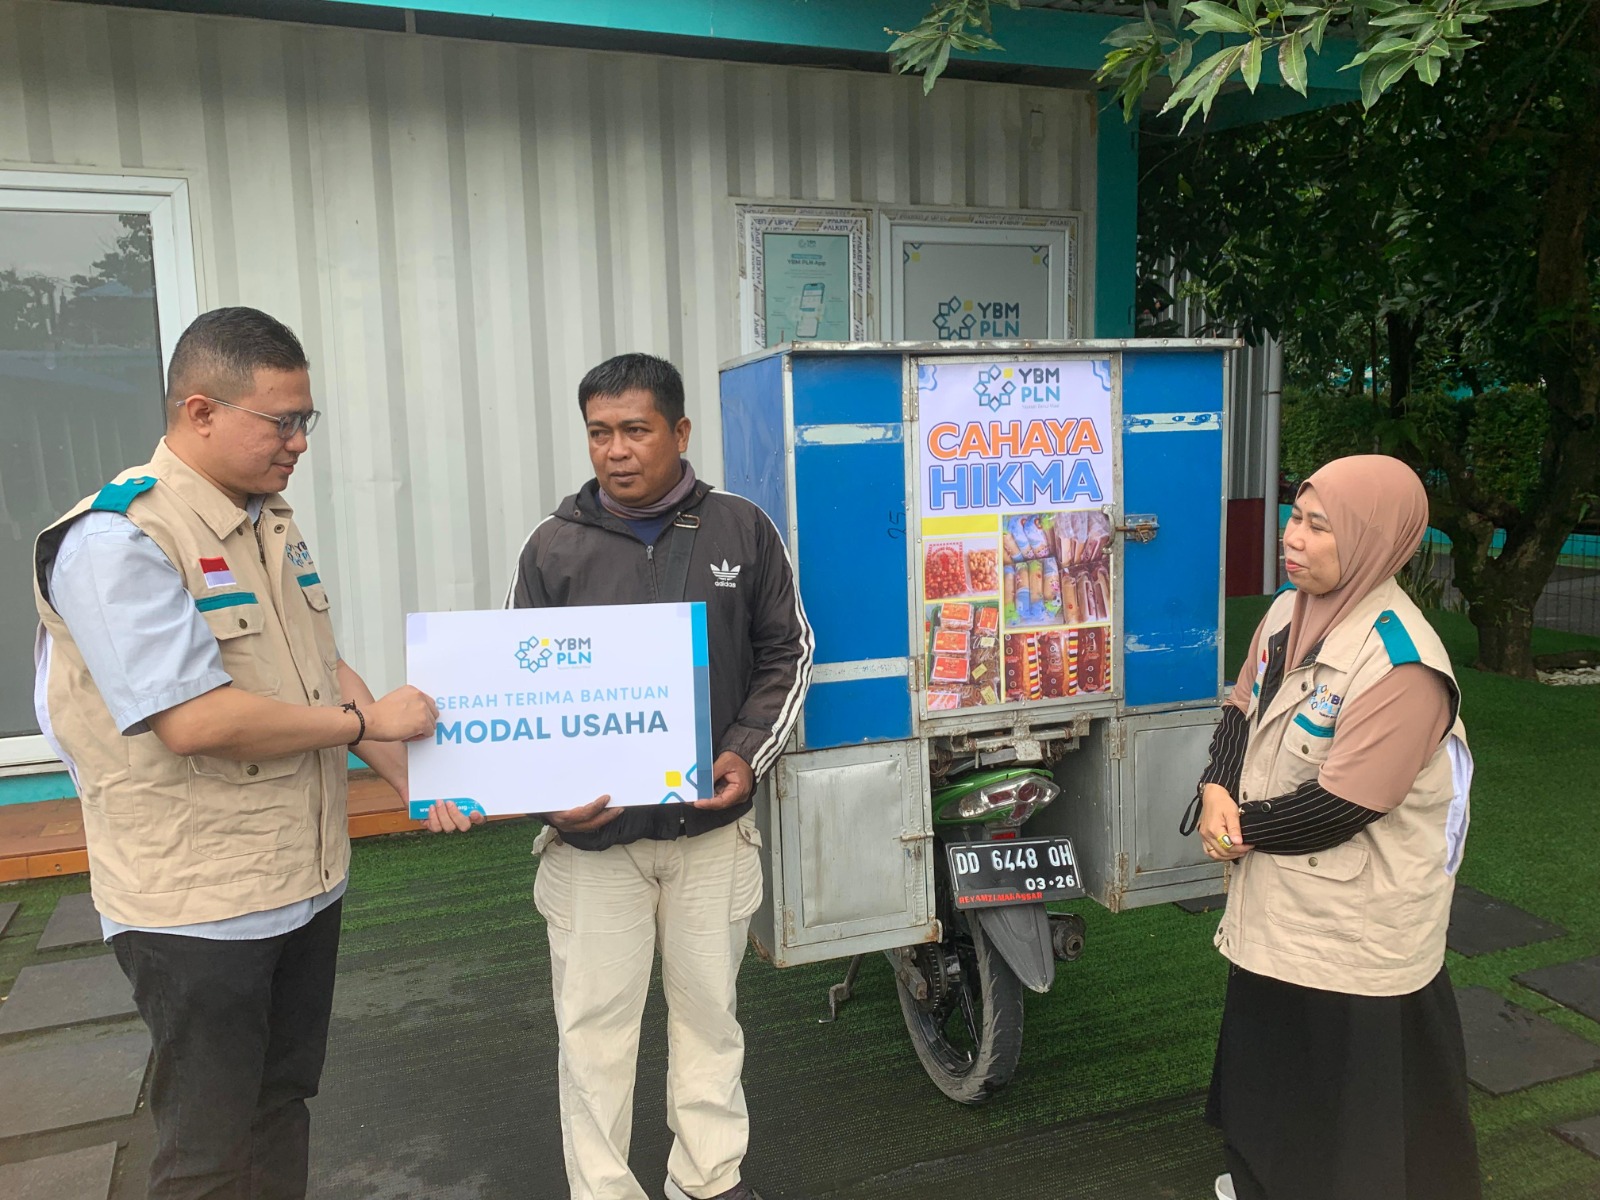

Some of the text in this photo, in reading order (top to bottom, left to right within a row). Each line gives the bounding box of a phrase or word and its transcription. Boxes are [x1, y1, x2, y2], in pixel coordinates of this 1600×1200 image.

[977, 302, 1019, 319] YBM
[980, 320, 1019, 337] PLN
[1018, 367, 1060, 384] YBM
[1021, 385, 1060, 402] PLN
[927, 417, 1103, 461] CAHAYA
[929, 459, 1103, 510] HIKMA
[715, 577, 736, 588] adidas
[554, 637, 591, 650] YBM
[557, 651, 591, 665] PLN
[436, 686, 668, 710] SERAH TERIMA BANTUAN
[436, 710, 668, 745] MODAL USAHA
[956, 852, 980, 875] DD
[991, 847, 1039, 871] 6448
